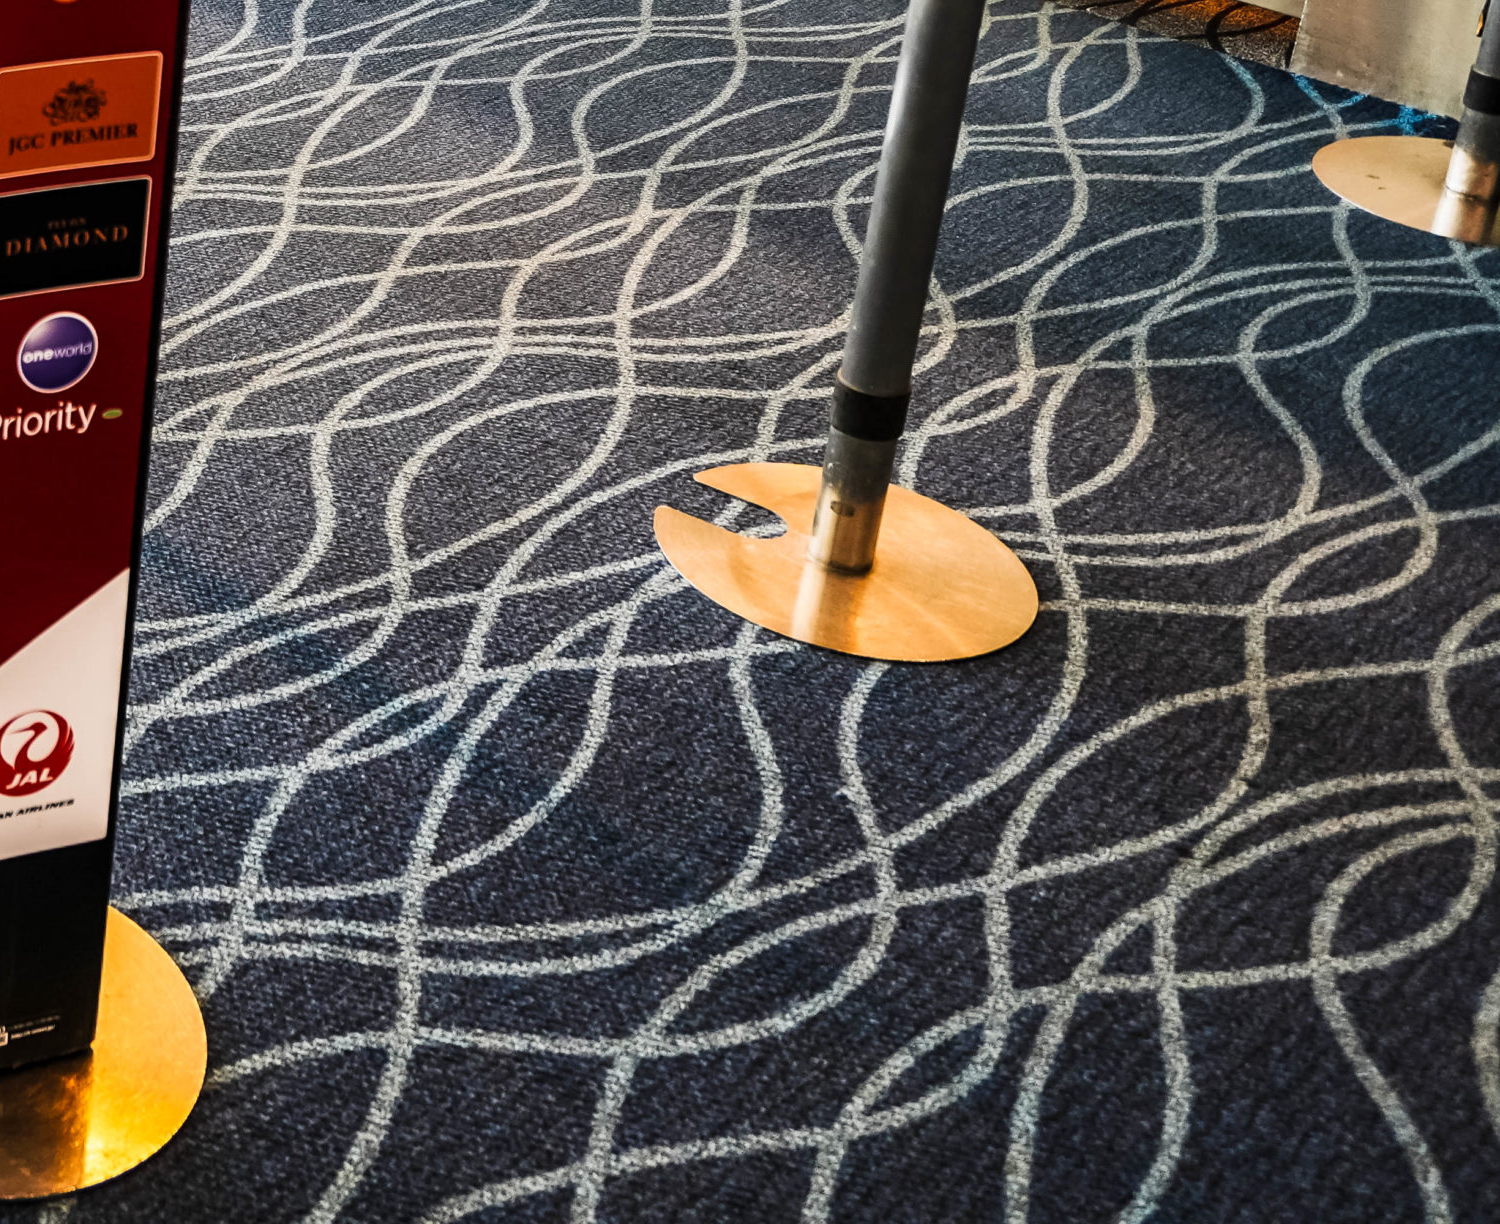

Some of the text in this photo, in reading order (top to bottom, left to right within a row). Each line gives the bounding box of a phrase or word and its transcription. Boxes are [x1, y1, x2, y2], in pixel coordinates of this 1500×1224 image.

[8, 122, 138, 156] JGC PREMIER
[5, 224, 129, 258] DIAMOND
[22, 341, 94, 364] oneworld
[5, 767, 54, 790] JAL
